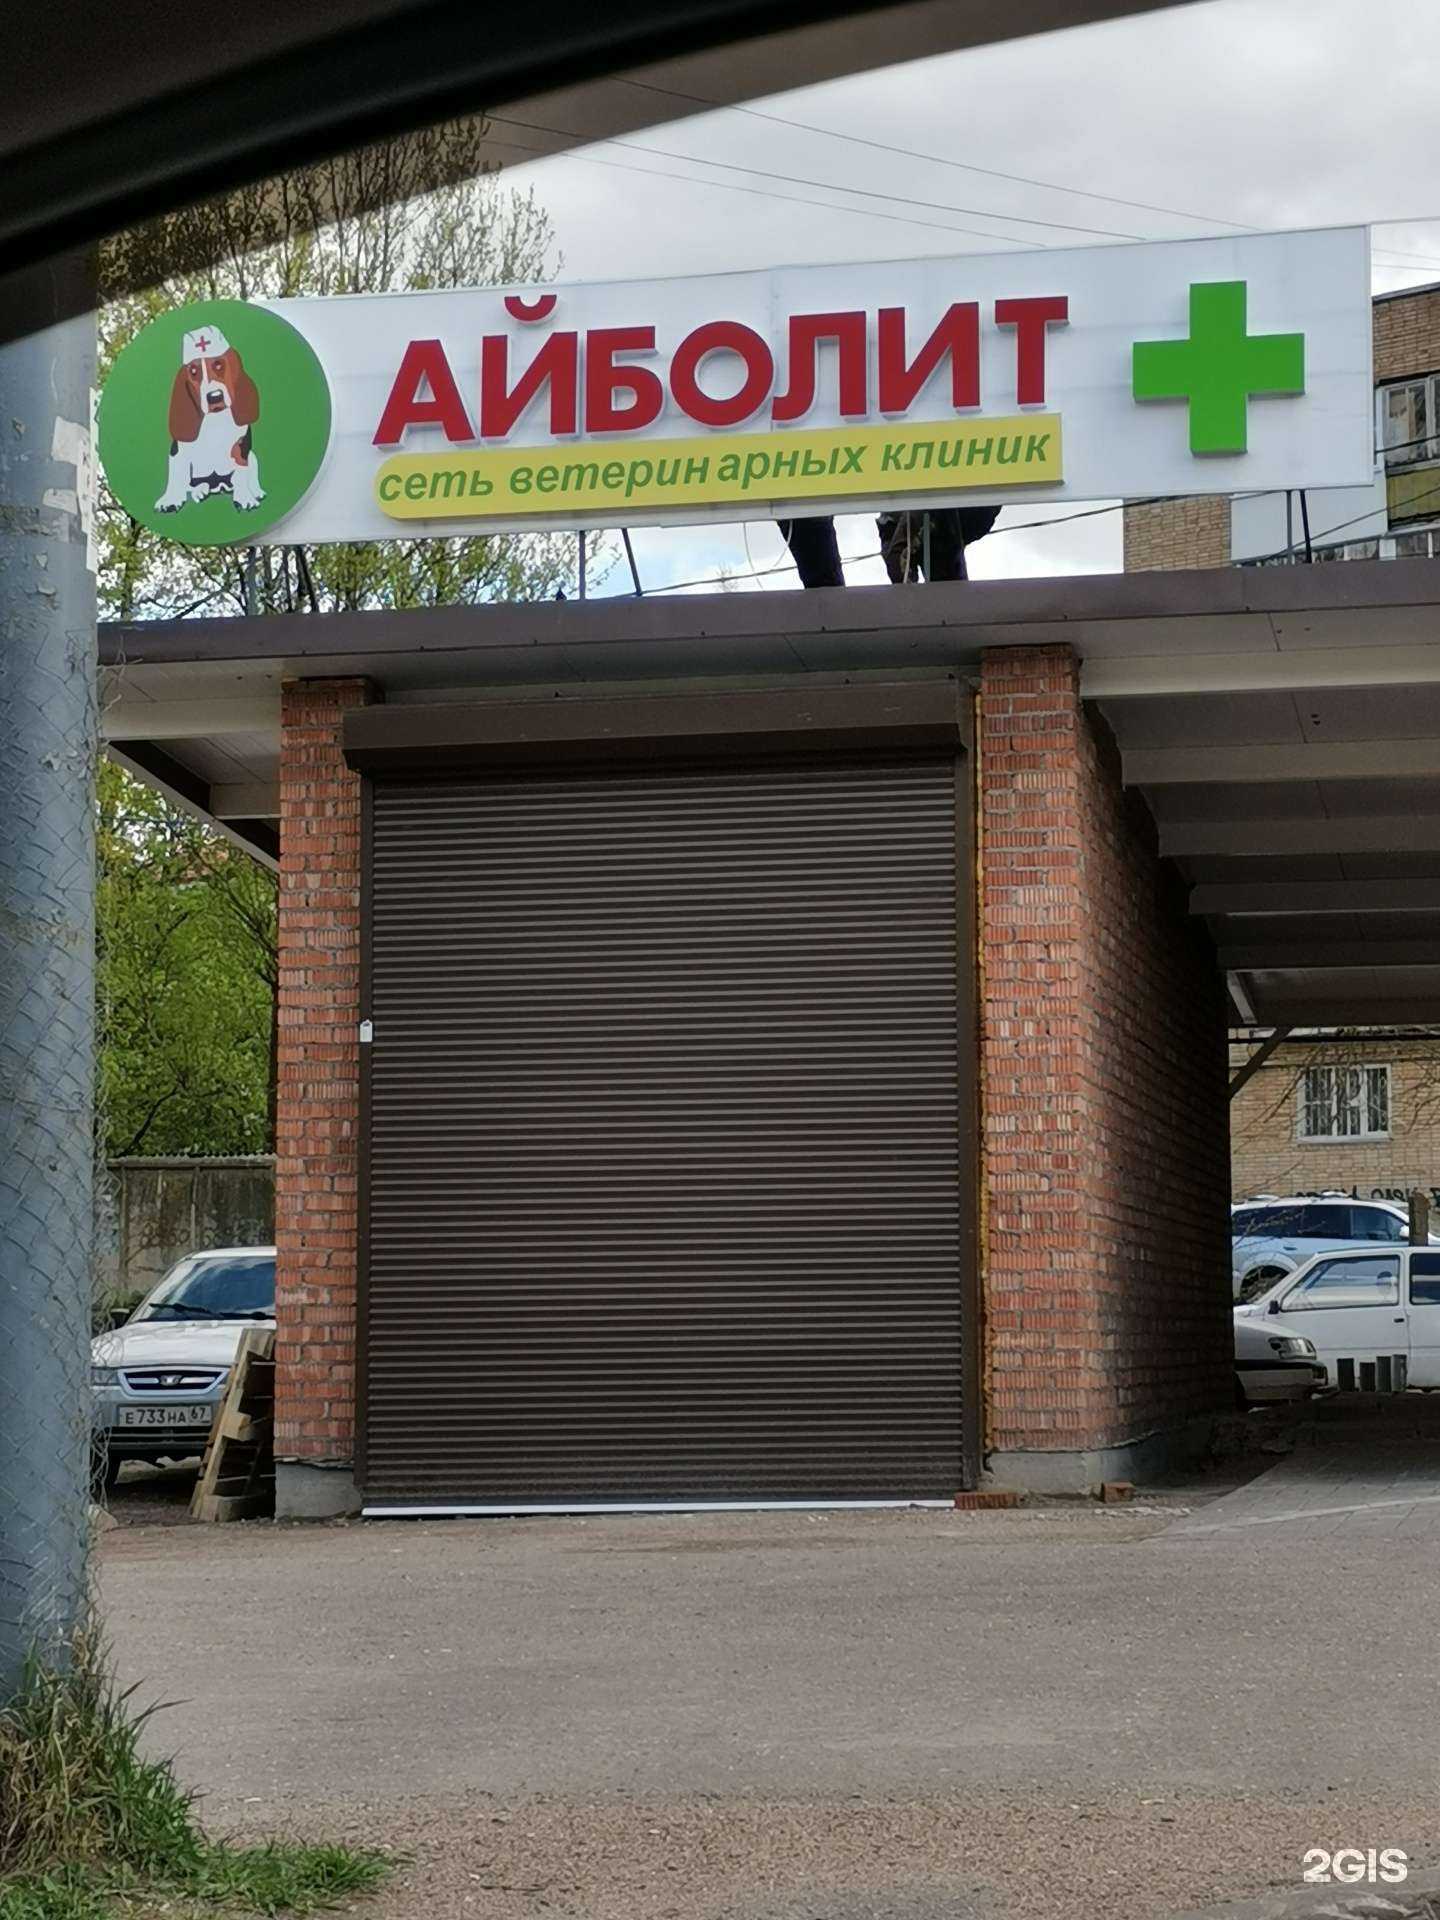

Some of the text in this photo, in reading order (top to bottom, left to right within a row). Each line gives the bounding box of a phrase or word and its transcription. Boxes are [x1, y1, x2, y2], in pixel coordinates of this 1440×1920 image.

[372, 294, 1068, 446] АЙБОЛИТ
[379, 470, 494, 501] сеть
[881, 432, 1051, 471] клиник
